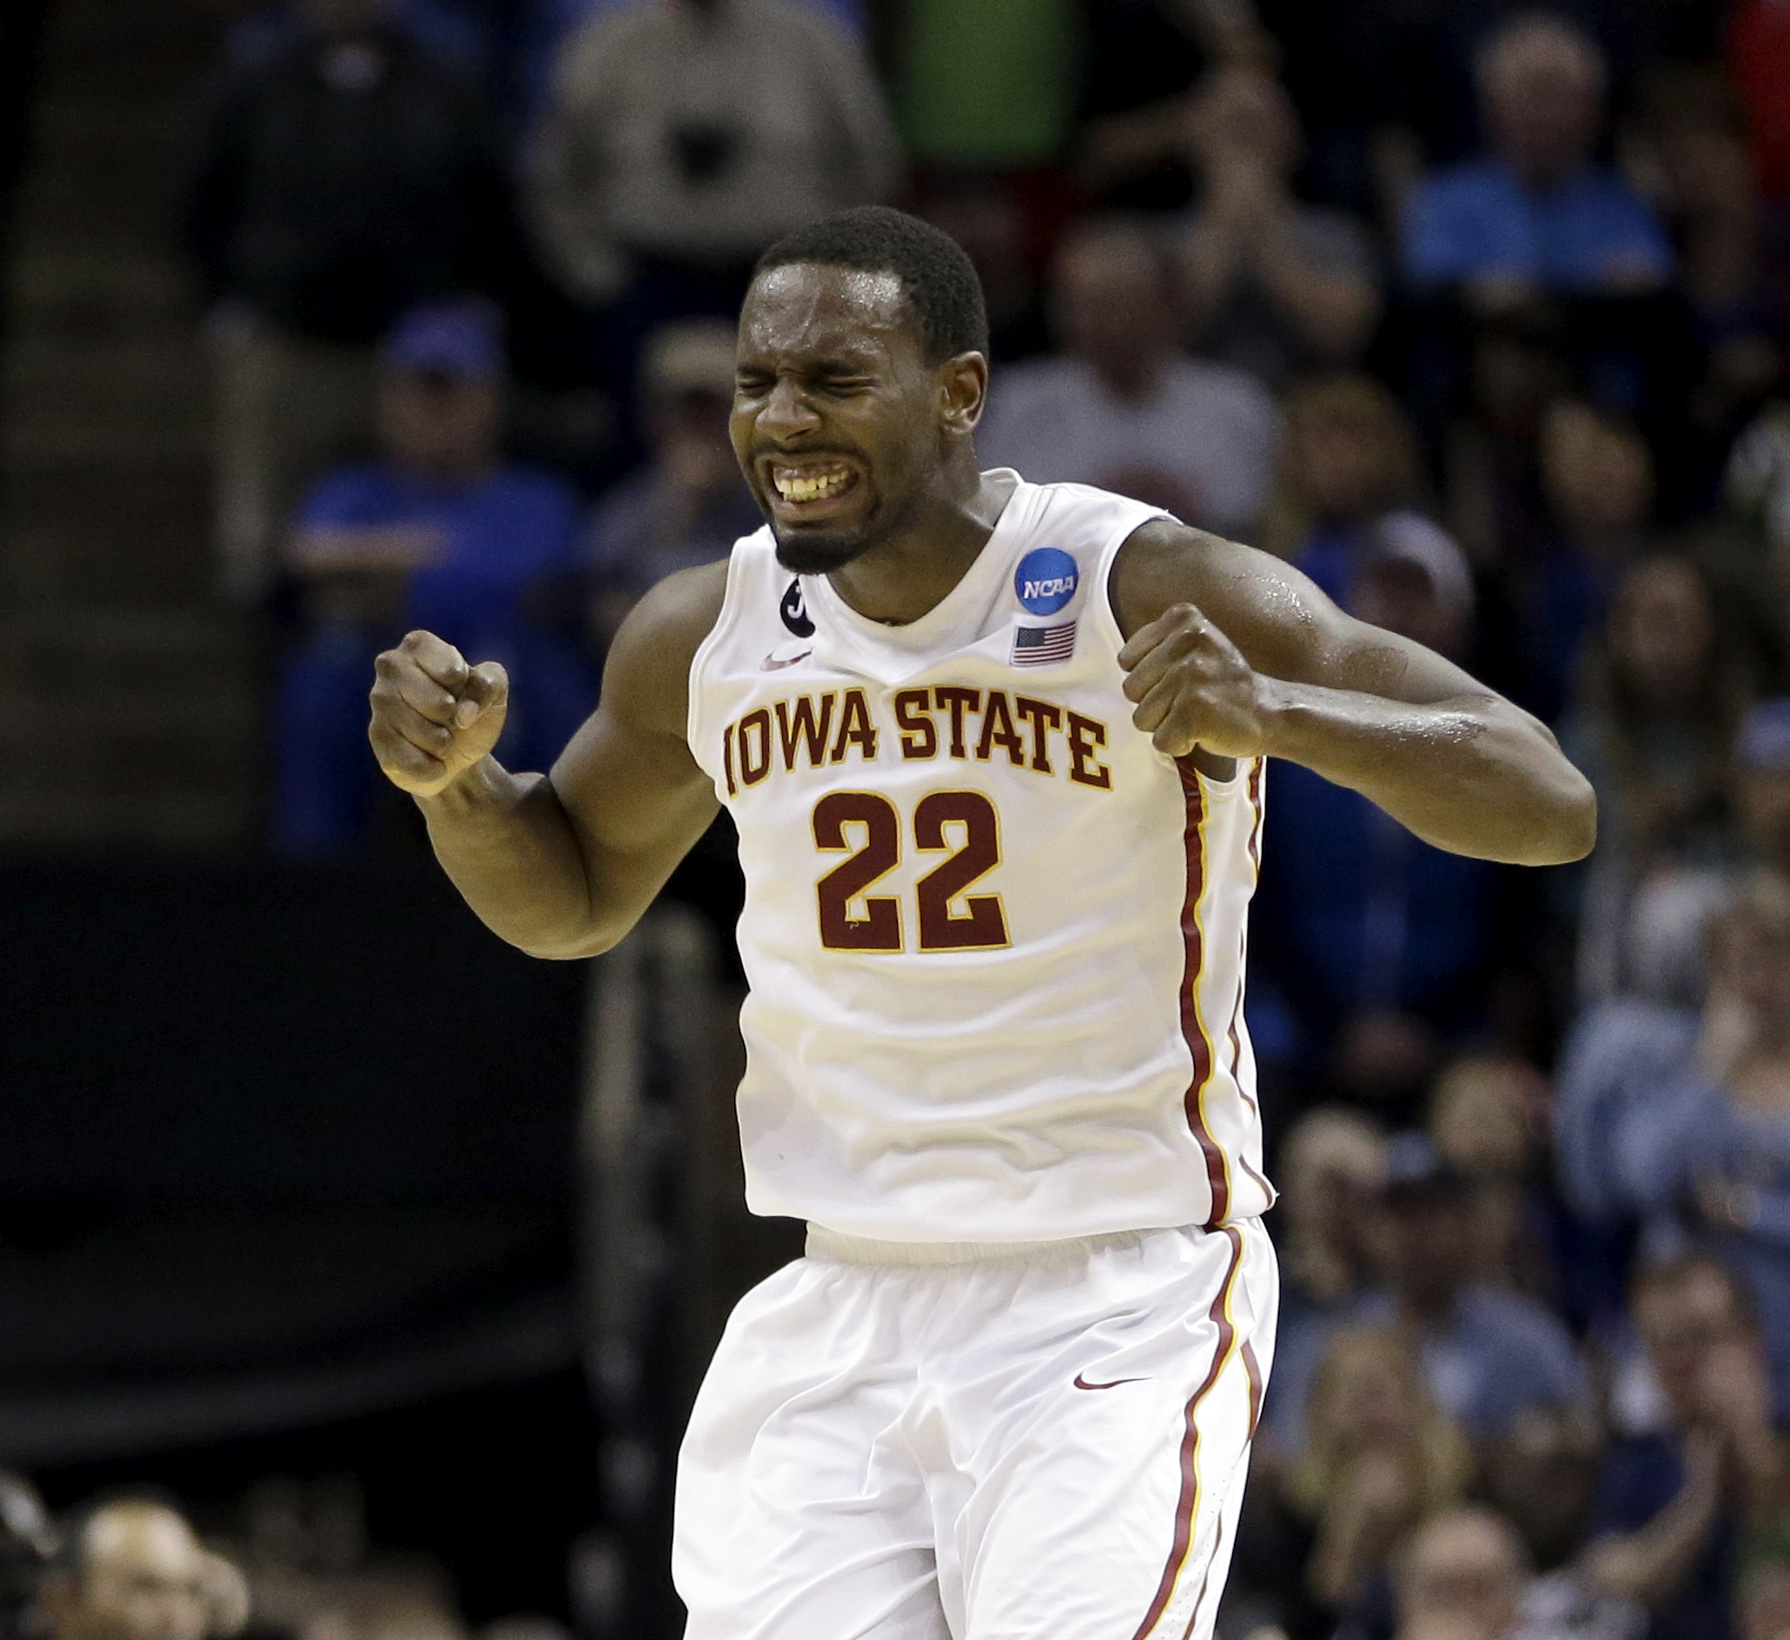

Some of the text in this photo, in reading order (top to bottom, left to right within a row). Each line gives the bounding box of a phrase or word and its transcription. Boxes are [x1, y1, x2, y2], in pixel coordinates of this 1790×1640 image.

[1023, 575, 1075, 599] NCAA
[722, 685, 1113, 798] IOWA STATE
[811, 788, 1013, 953] 22
